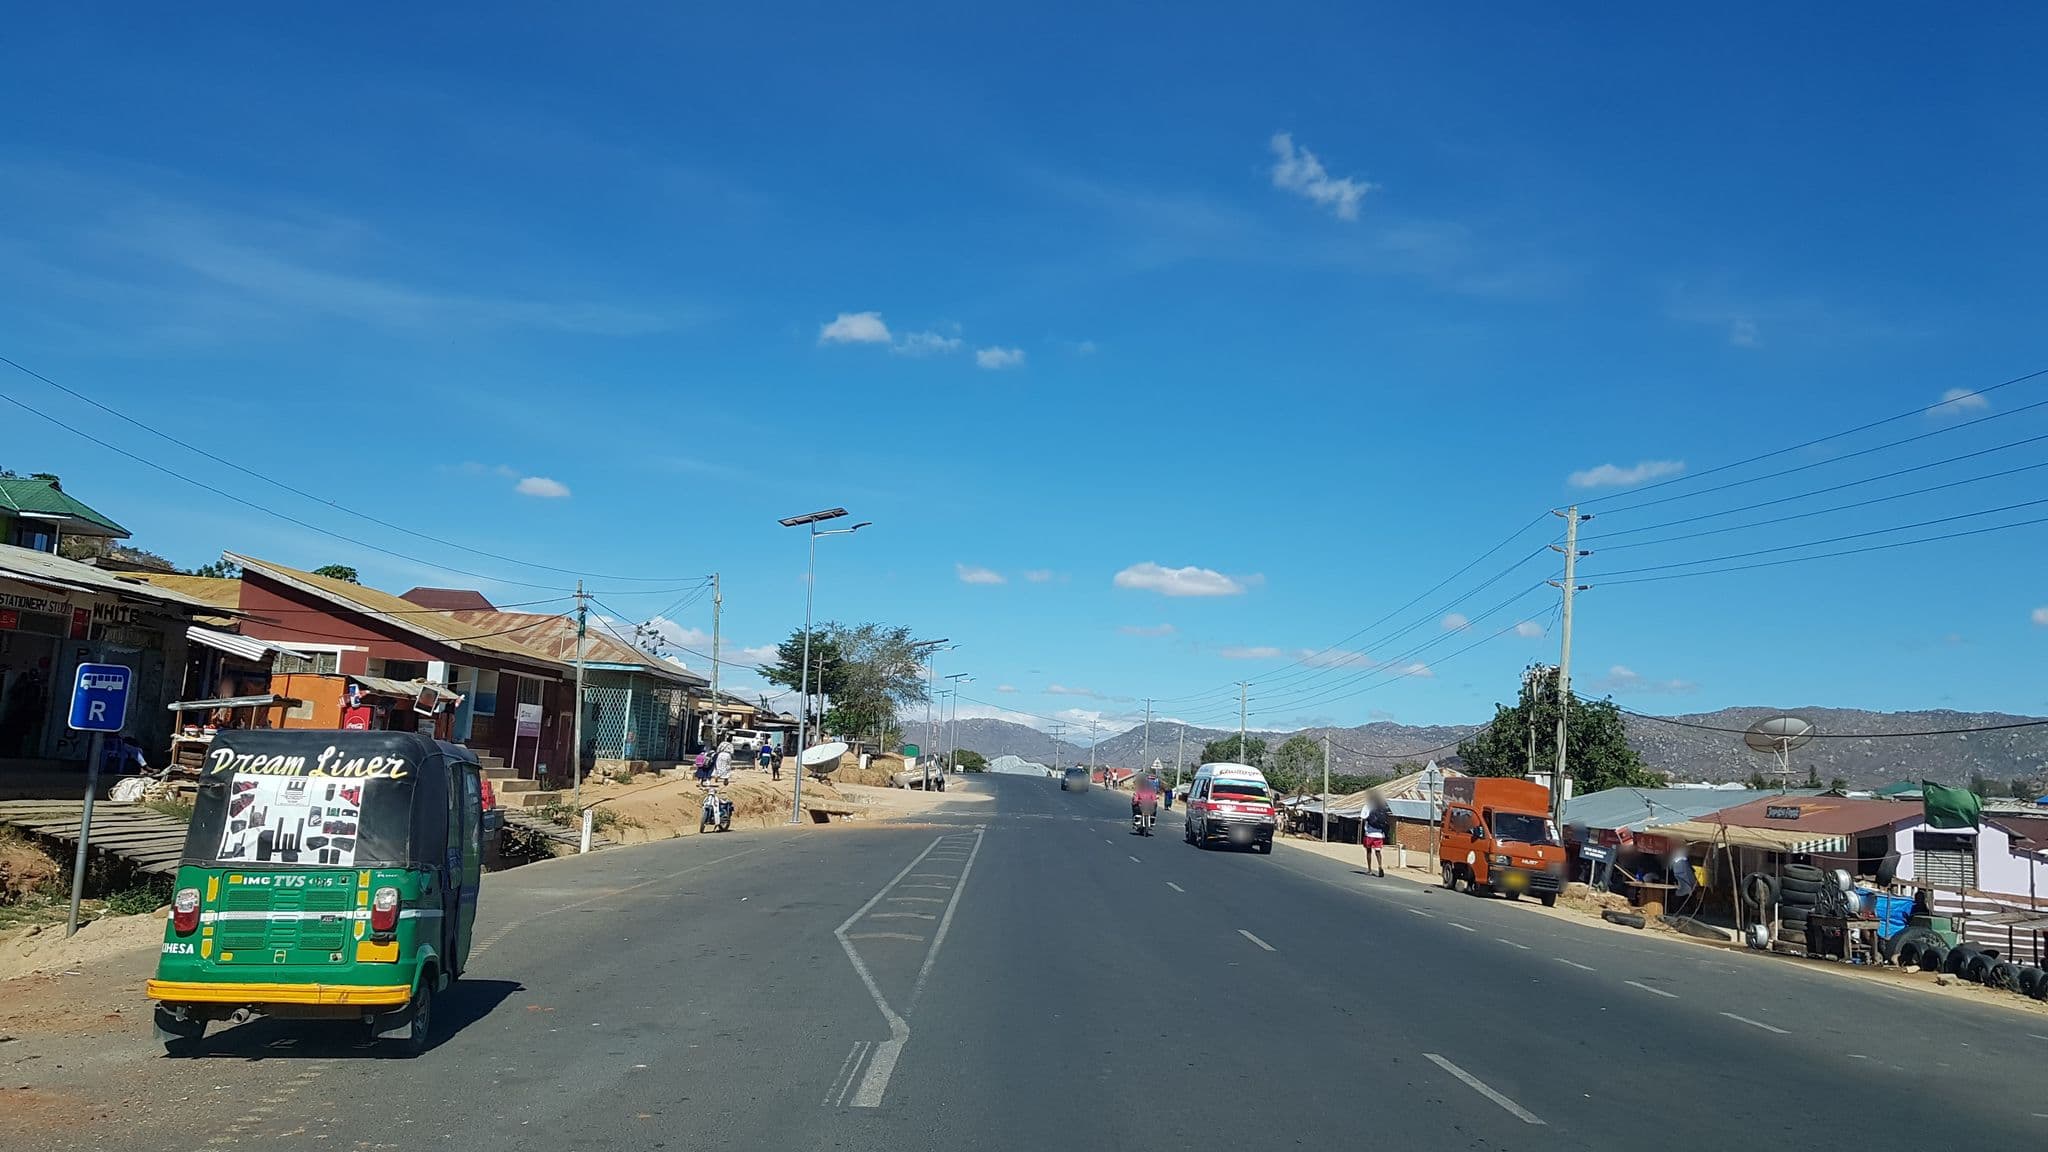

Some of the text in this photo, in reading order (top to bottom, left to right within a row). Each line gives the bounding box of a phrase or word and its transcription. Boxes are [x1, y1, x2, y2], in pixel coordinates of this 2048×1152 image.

[89, 700, 106, 721] R
[211, 746, 408, 779] Dream Liner
[274, 875, 306, 887] TVS
